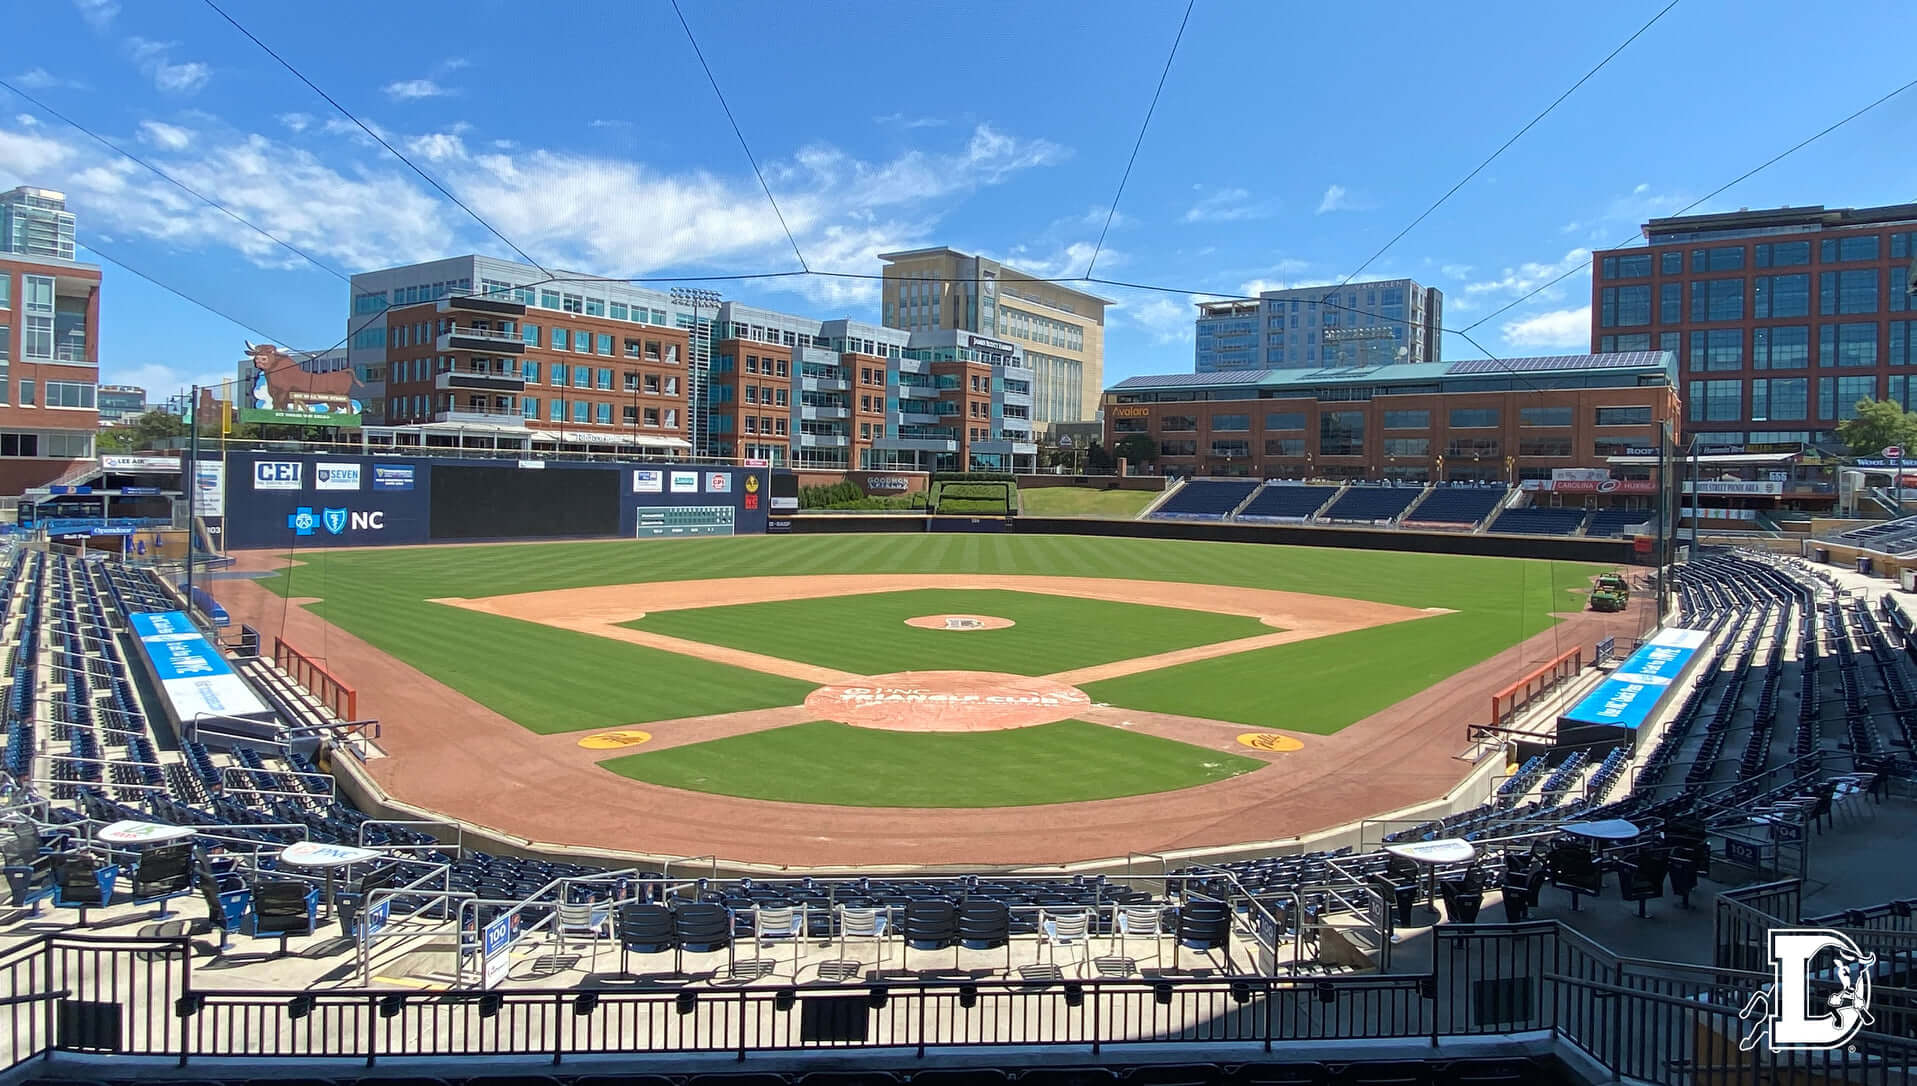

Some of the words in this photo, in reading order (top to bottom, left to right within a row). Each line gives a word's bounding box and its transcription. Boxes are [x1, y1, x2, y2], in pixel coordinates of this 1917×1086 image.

[257, 463, 299, 481] CEI
[330, 469, 359, 479] SEVEN
[351, 511, 384, 530] NC
[1730, 844, 1753, 858] 102
[488, 924, 506, 945] 100
